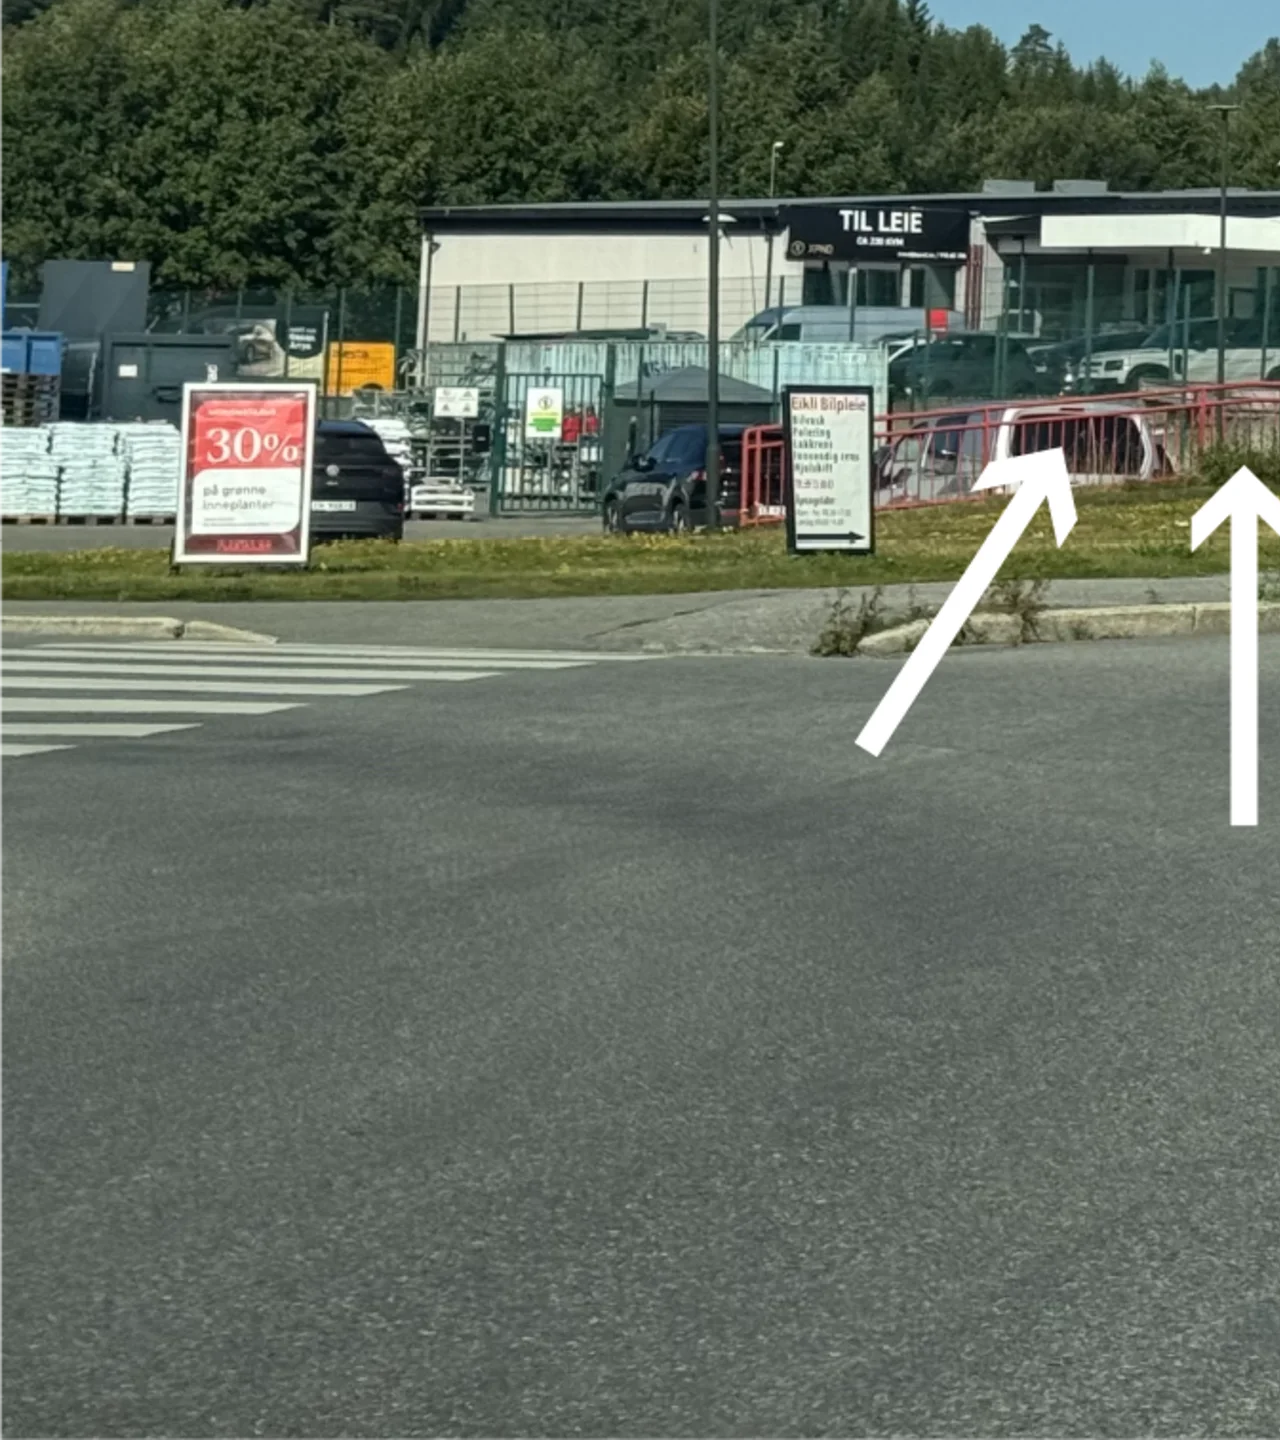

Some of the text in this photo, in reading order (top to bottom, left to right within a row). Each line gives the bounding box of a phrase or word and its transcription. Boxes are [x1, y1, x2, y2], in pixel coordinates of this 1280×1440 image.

[838, 209, 923, 233] TIL LEIE
[856, 236, 868, 245] CA
[791, 397, 866, 415] Eikli Bilpleie
[793, 427, 831, 439] Polering
[206, 427, 300, 463] 30%
[203, 484, 267, 497] på grønne
[202, 498, 275, 511] inneplanter
